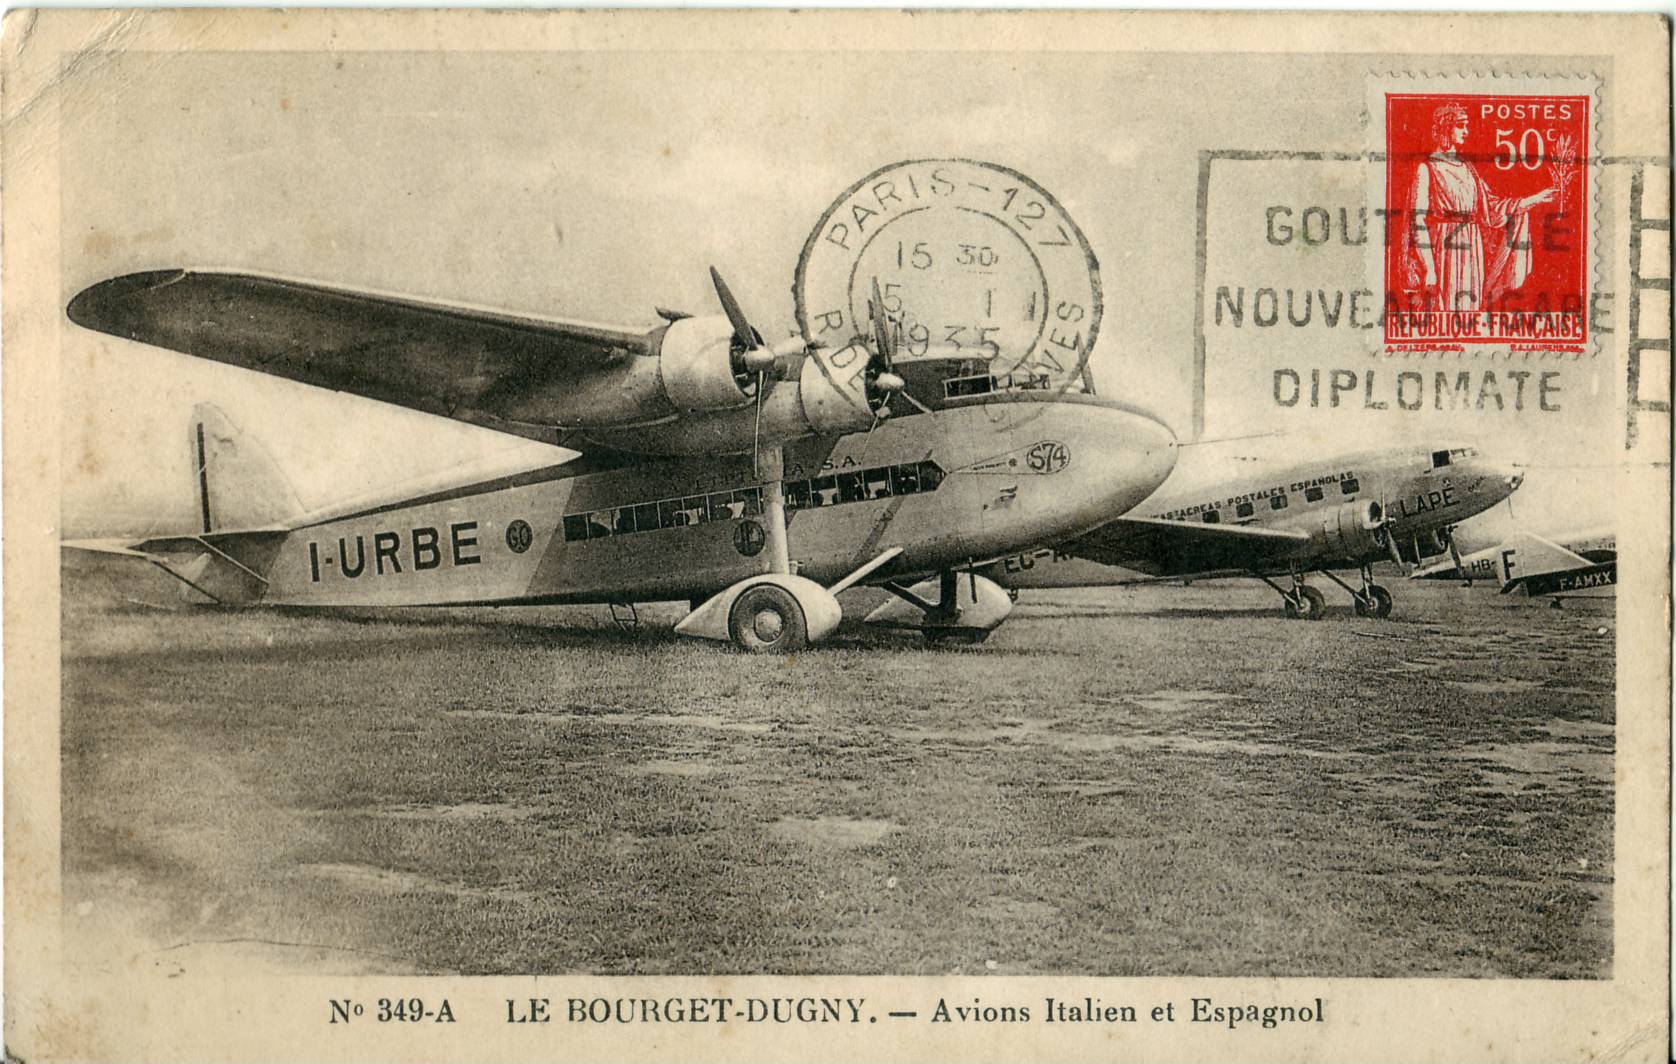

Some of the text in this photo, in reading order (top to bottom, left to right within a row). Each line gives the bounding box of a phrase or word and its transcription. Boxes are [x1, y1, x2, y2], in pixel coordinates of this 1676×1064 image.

[1481, 103, 1572, 121] POSTES
[1265, 205, 1572, 254] GOUTEZ LE
[1215, 286, 1434, 329] NOUVEAU
[1273, 369, 1563, 412] DIPLOMATE
[1030, 442, 1067, 473] S74
[1227, 486, 1285, 507] POSTALES
[1400, 487, 1460, 518] LAPE
[309, 521, 481, 582] I-URBE
[1502, 549, 1516, 580] F
[1559, 571, 1612, 591] F-AMXX
